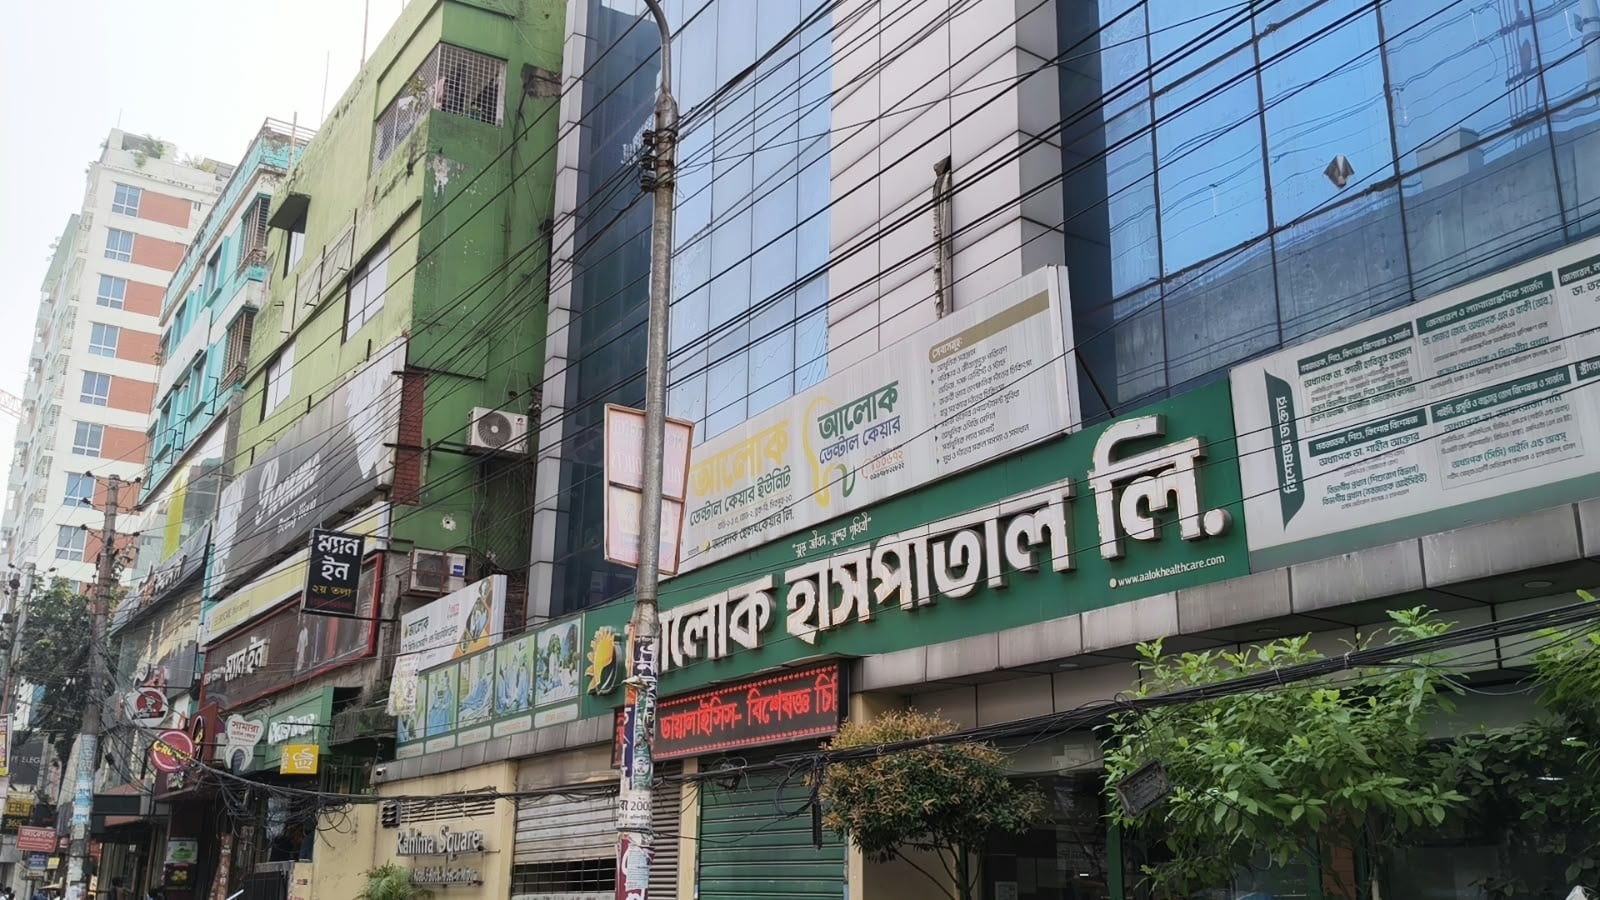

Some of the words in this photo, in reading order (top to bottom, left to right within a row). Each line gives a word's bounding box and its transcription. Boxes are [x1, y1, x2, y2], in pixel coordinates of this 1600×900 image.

[1458, 307, 1465, 316] ও
[1520, 279, 1544, 295] সার্জন
[1571, 285, 1586, 296] ডা.
[1468, 315, 1496, 331] অধ্যাপক
[1303, 372, 1333, 389] অধ্যাপক
[1333, 368, 1344, 379] ডা.
[1344, 360, 1363, 375] কাজী
[1511, 380, 1538, 396] বিশেষজ্ঞ
[1539, 380, 1545, 388] ও
[1545, 372, 1565, 387] সার্জন
[817, 380, 899, 440] আলোক
[1275, 395, 1291, 439] ডাক্তার
[1390, 415, 1419, 430] বিশেষজ্ঞ
[819, 433, 860, 465] ডেন্টাল
[862, 415, 901, 446] কেয়ার
[1318, 451, 1352, 467] অধ্যাপক
[1352, 447, 1364, 458] ডা.
[1366, 440, 1389, 454] শাহীন
[1390, 432, 1420, 447] আক্তার
[690, 420, 790, 497] আলোক
[1281, 438, 1298, 494] বিশেষজ্ঞ
[1450, 453, 1483, 470] অধ্যাপক
[1483, 446, 1507, 461] (সিসি)
[689, 498, 722, 527] ডেন্টাল
[724, 484, 755, 512] কেয়ার
[756, 465, 791, 498] ইউনিট
[317, 534, 361, 556] ম্যান
[784, 478, 1078, 646] হাসপাতাল
[1087, 413, 1233, 562] লি.
[321, 555, 351, 581] ইন
[1117, 554, 1226, 587] www.aalokhealthcare.com
[311, 584, 328, 594] ২য়
[330, 586, 352, 597] তলা
[224, 647, 248, 682] ম্যান
[246, 636, 271, 674] ইন
[746, 687, 811, 727] বিশেষজ্ঞ
[231, 720, 260, 734] সামারা
[397, 828, 434, 854] Rahima
[437, 824, 481, 861] Square
